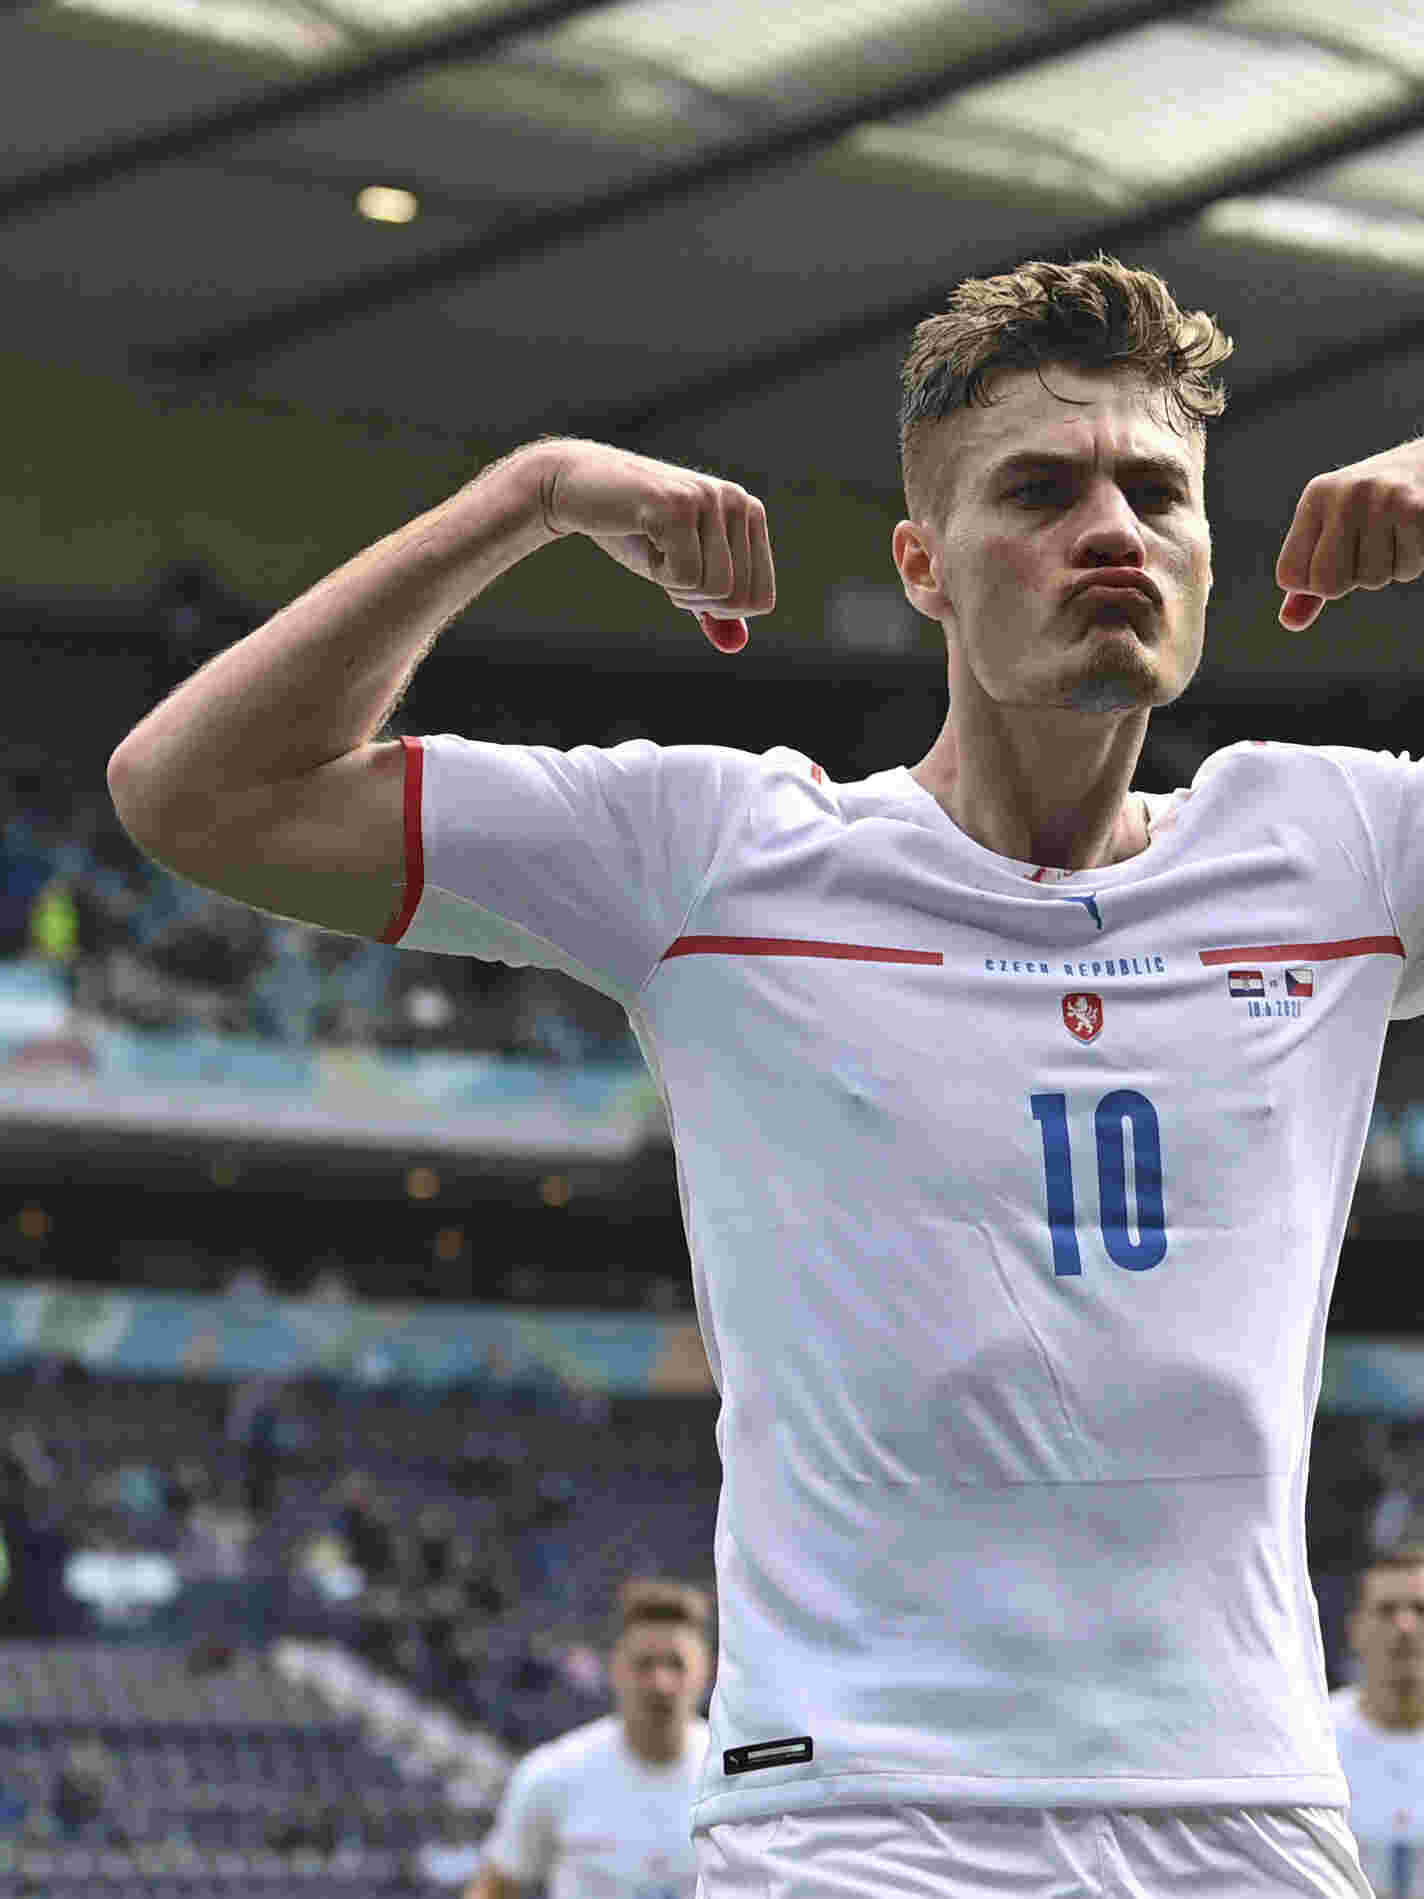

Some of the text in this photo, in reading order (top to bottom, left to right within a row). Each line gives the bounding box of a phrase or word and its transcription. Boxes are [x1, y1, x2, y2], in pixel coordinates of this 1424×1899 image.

[985, 956, 1166, 977] CZECH REPUBLIC
[1030, 1089, 1167, 1276] 10
